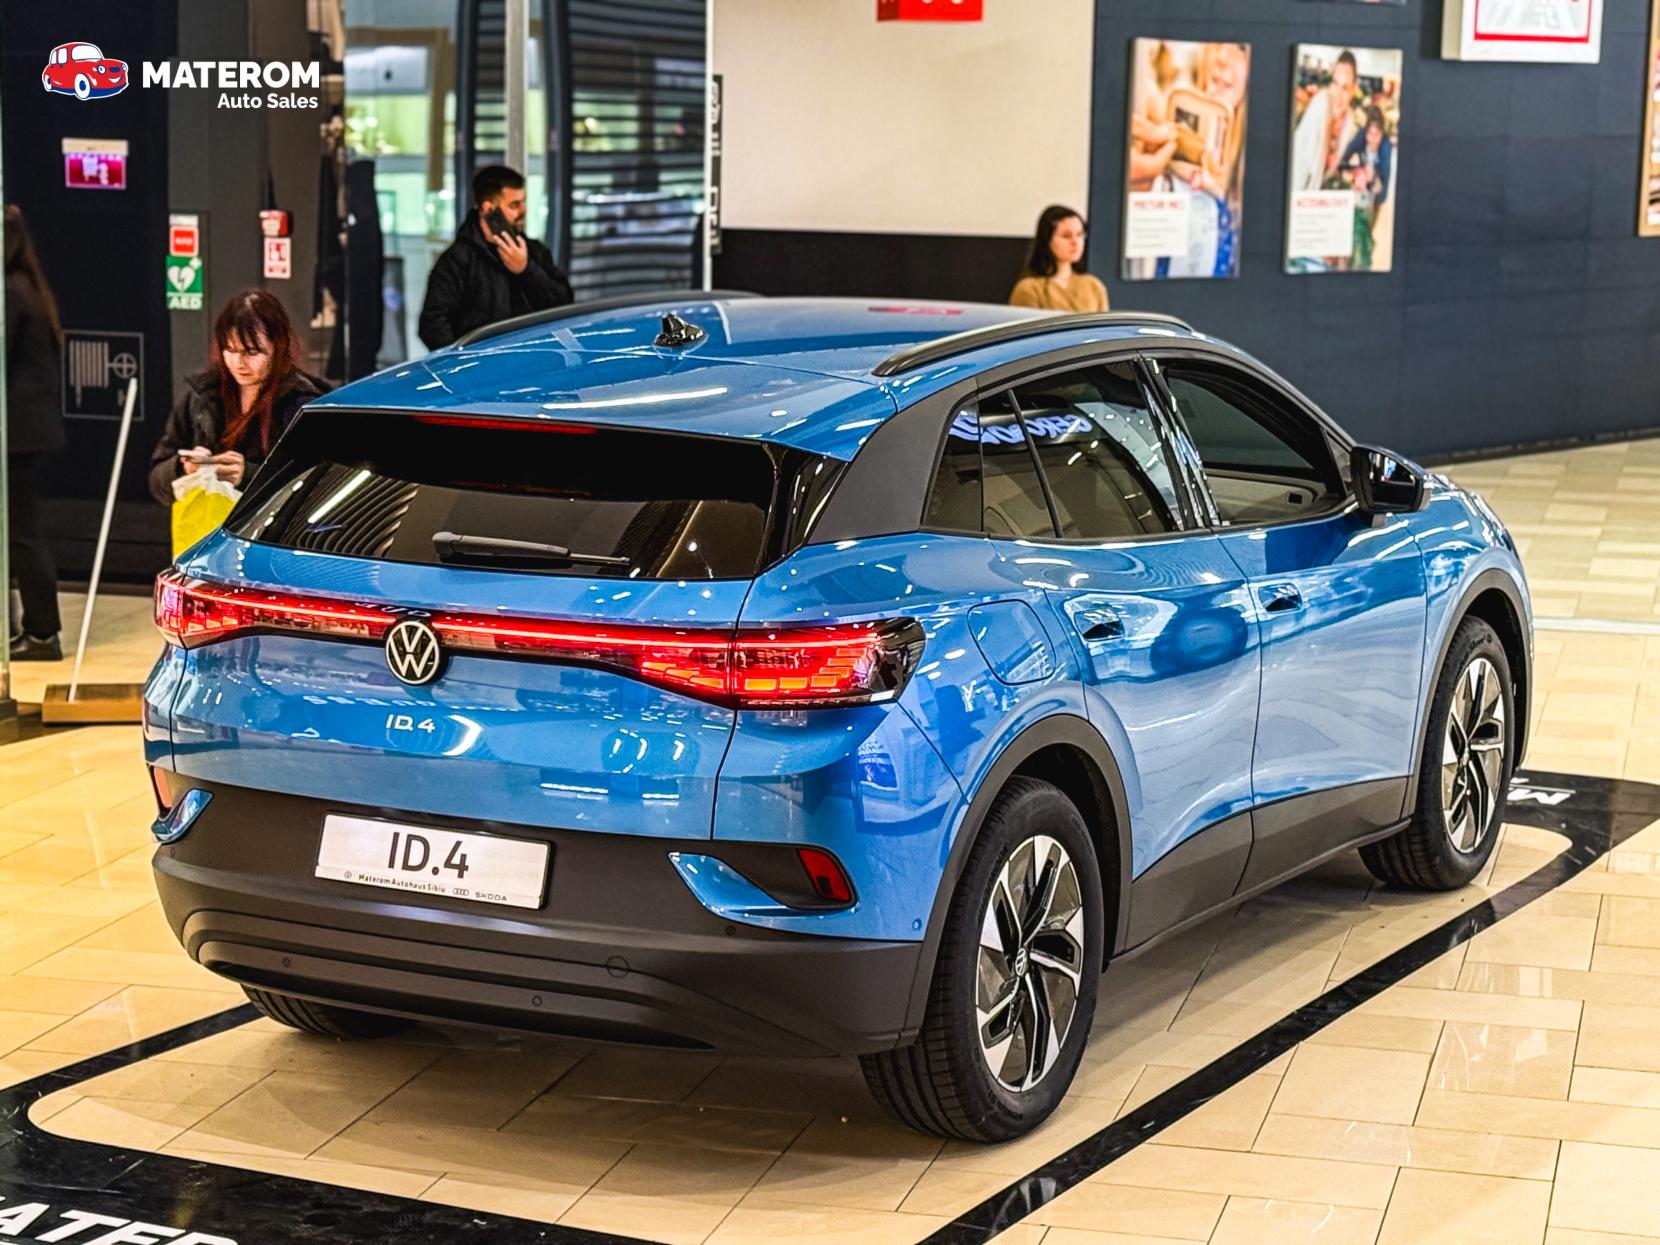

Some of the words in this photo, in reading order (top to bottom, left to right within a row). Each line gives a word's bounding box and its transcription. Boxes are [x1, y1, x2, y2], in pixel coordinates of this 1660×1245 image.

[168, 296, 202, 310] AED
[387, 831, 469, 879] ID.4
[358, 873, 390, 885] Materom
[391, 878, 426, 890] Autohaus
[427, 883, 446, 893] Sibiu
